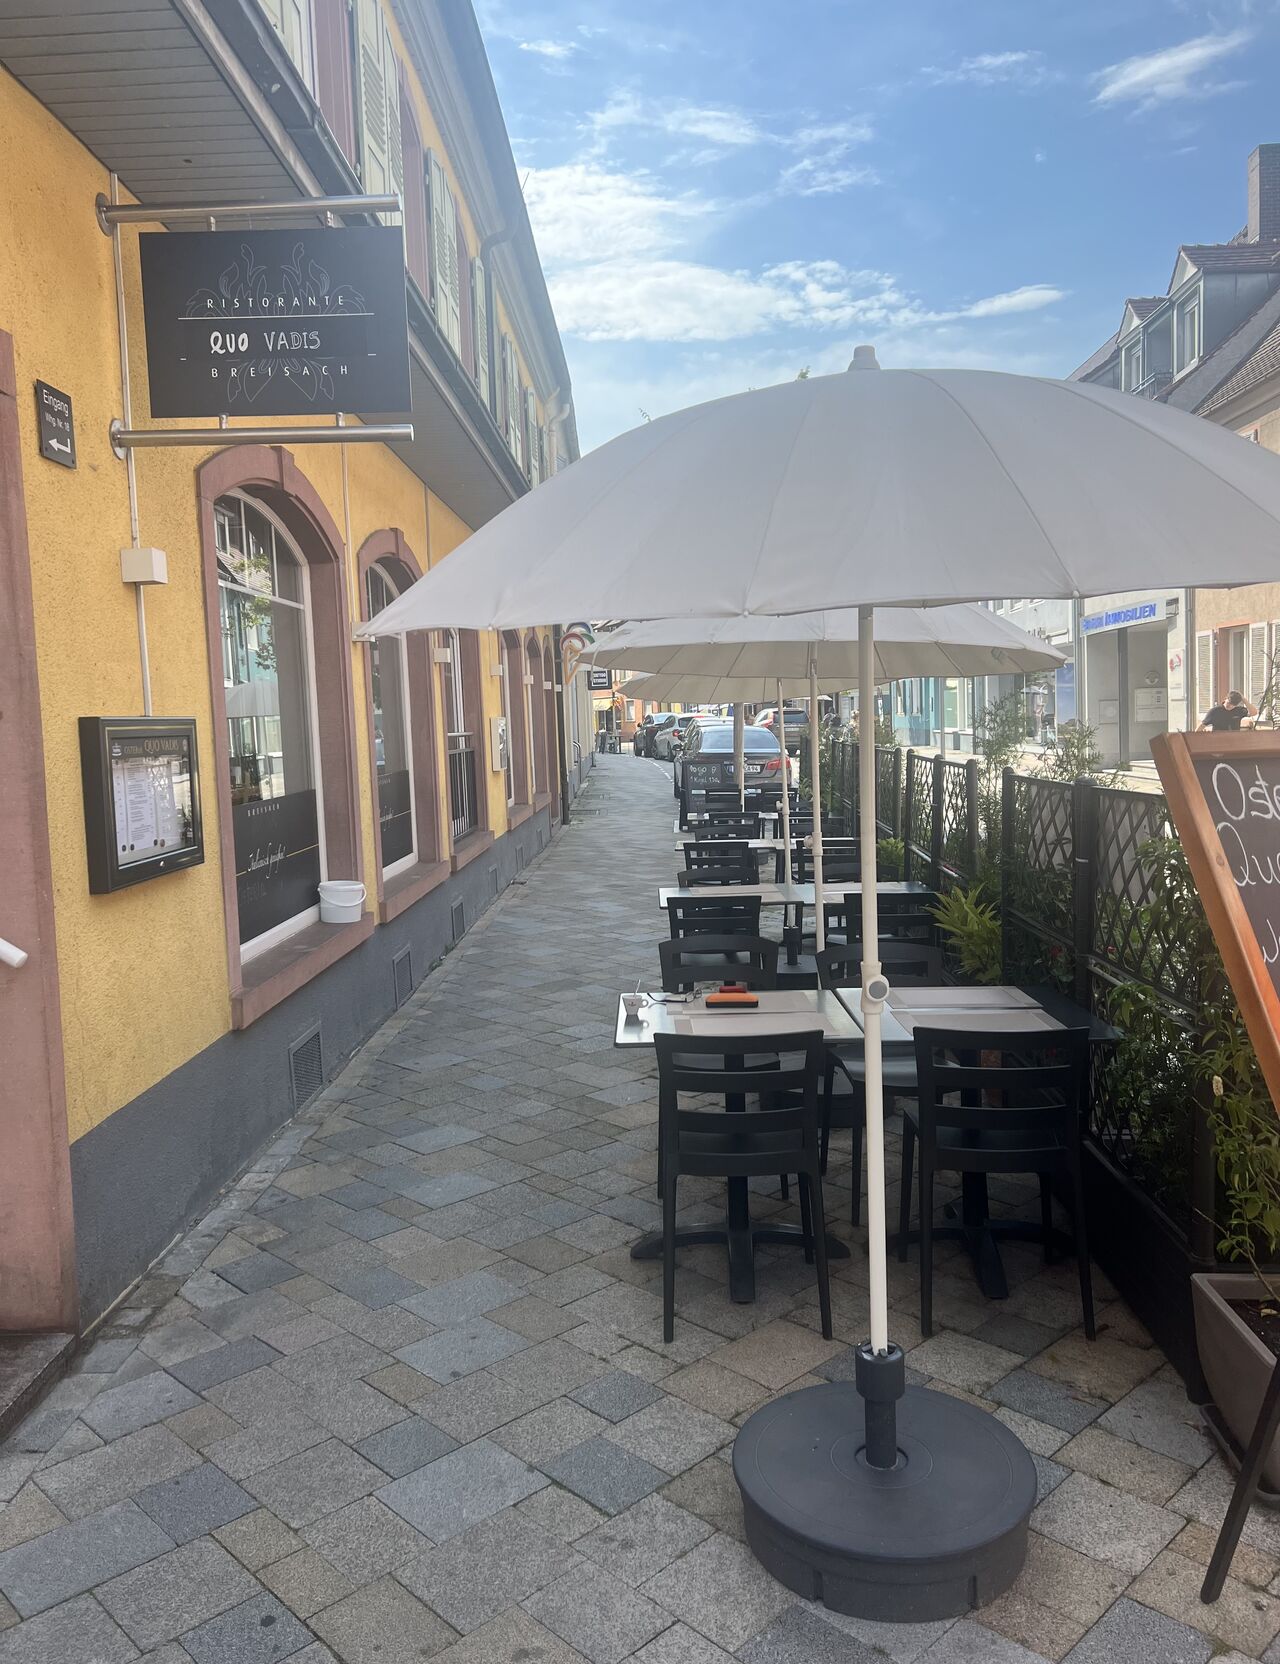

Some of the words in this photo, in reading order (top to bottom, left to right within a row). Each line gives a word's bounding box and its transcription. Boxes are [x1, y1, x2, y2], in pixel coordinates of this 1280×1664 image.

[207, 295, 344, 309] RISTORANTE
[210, 330, 249, 354] QUO
[263, 330, 321, 352] VADIS
[211, 365, 349, 378] BREISACH
[42, 389, 69, 417] Eingang
[144, 739, 160, 754] QUO
[1216, 821, 1280, 887] Qu
